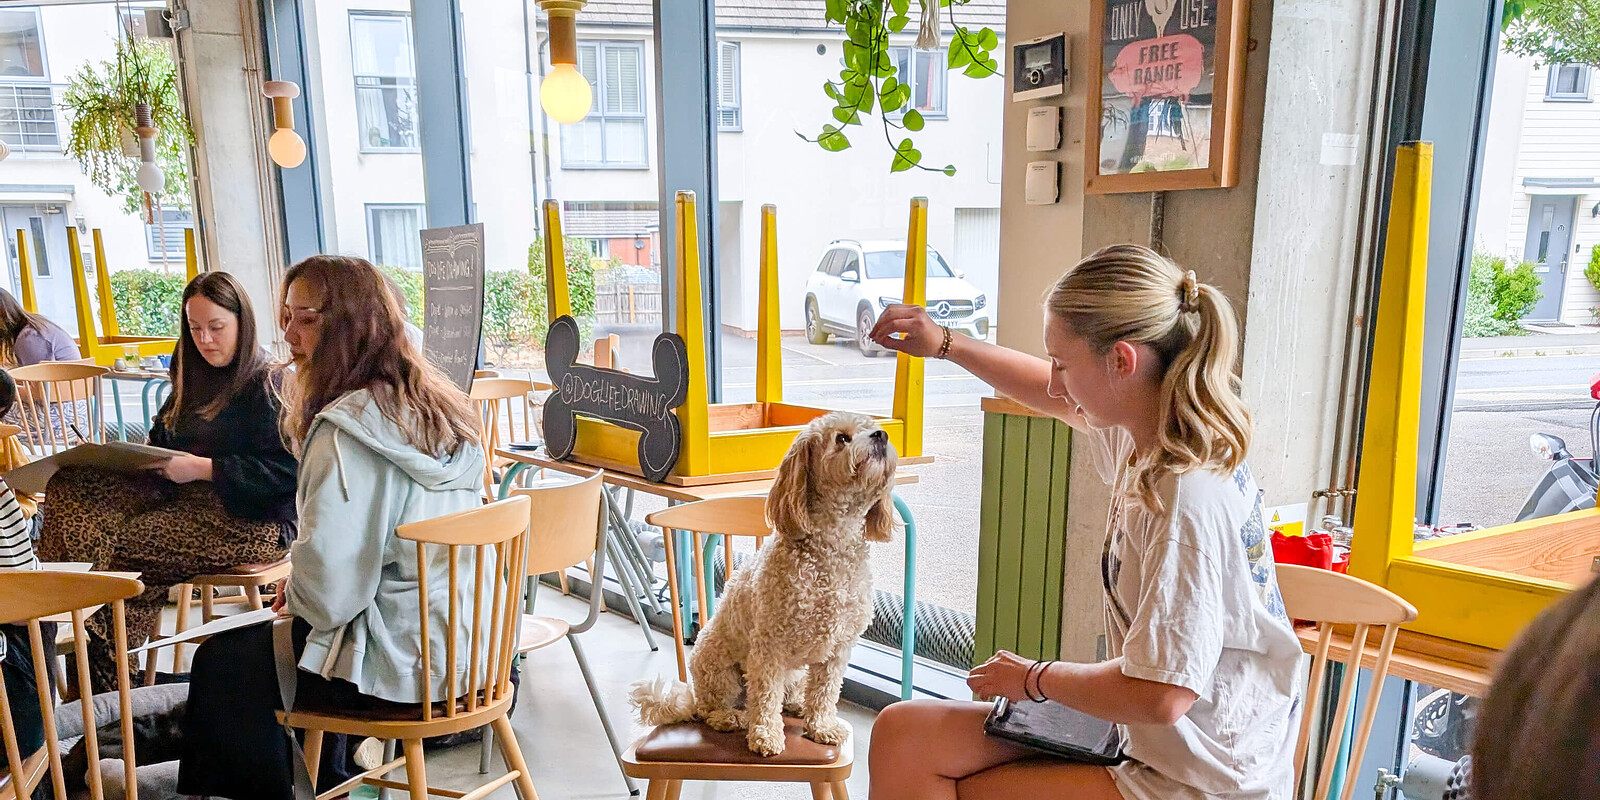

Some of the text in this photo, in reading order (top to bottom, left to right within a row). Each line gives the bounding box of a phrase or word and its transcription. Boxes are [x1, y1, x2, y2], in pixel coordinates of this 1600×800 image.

[1111, 0, 1209, 40] ONLY USE
[1139, 41, 1179, 64] FREE
[1134, 62, 1183, 84] RANGE
[561, 372, 667, 427] @DOGLIFEDRAWING
